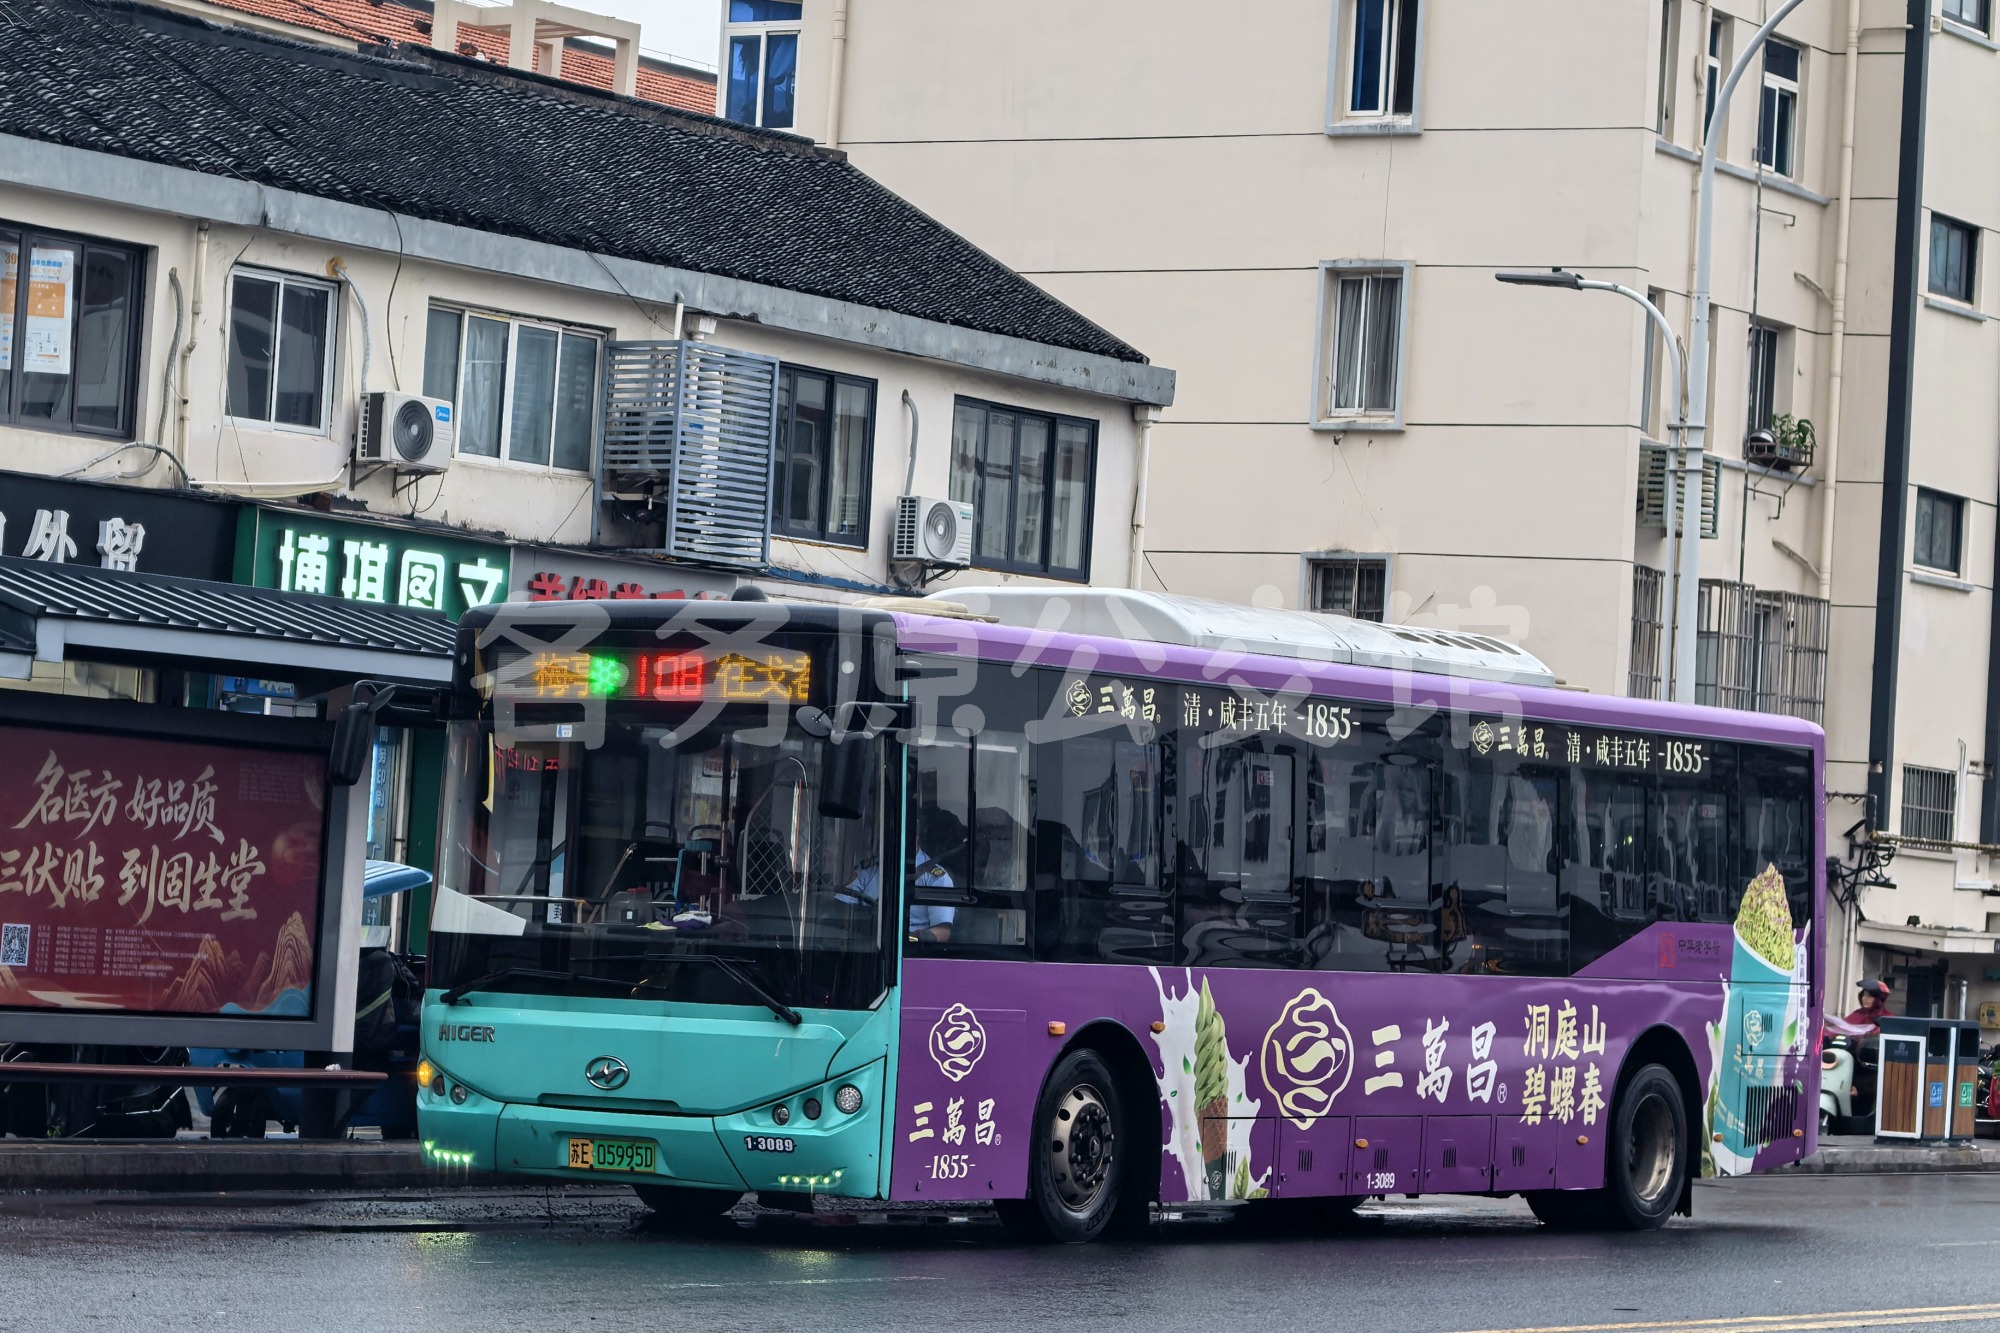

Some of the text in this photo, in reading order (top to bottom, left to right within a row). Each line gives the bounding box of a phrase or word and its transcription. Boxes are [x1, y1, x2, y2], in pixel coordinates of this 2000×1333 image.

[0, 509, 146, 572] 外贸
[638, 655, 703, 697] 108
[11, 748, 123, 840] 名医方
[125, 764, 225, 845] 好品质
[0, 838, 266, 926] 三伏贴 到固生堂
[438, 1024, 495, 1043] HIGER
[1524, 999, 1606, 1061] 洞庭山
[1519, 1062, 1606, 1126] 碧螺春
[1366, 1173, 1395, 1189] 1-3089
